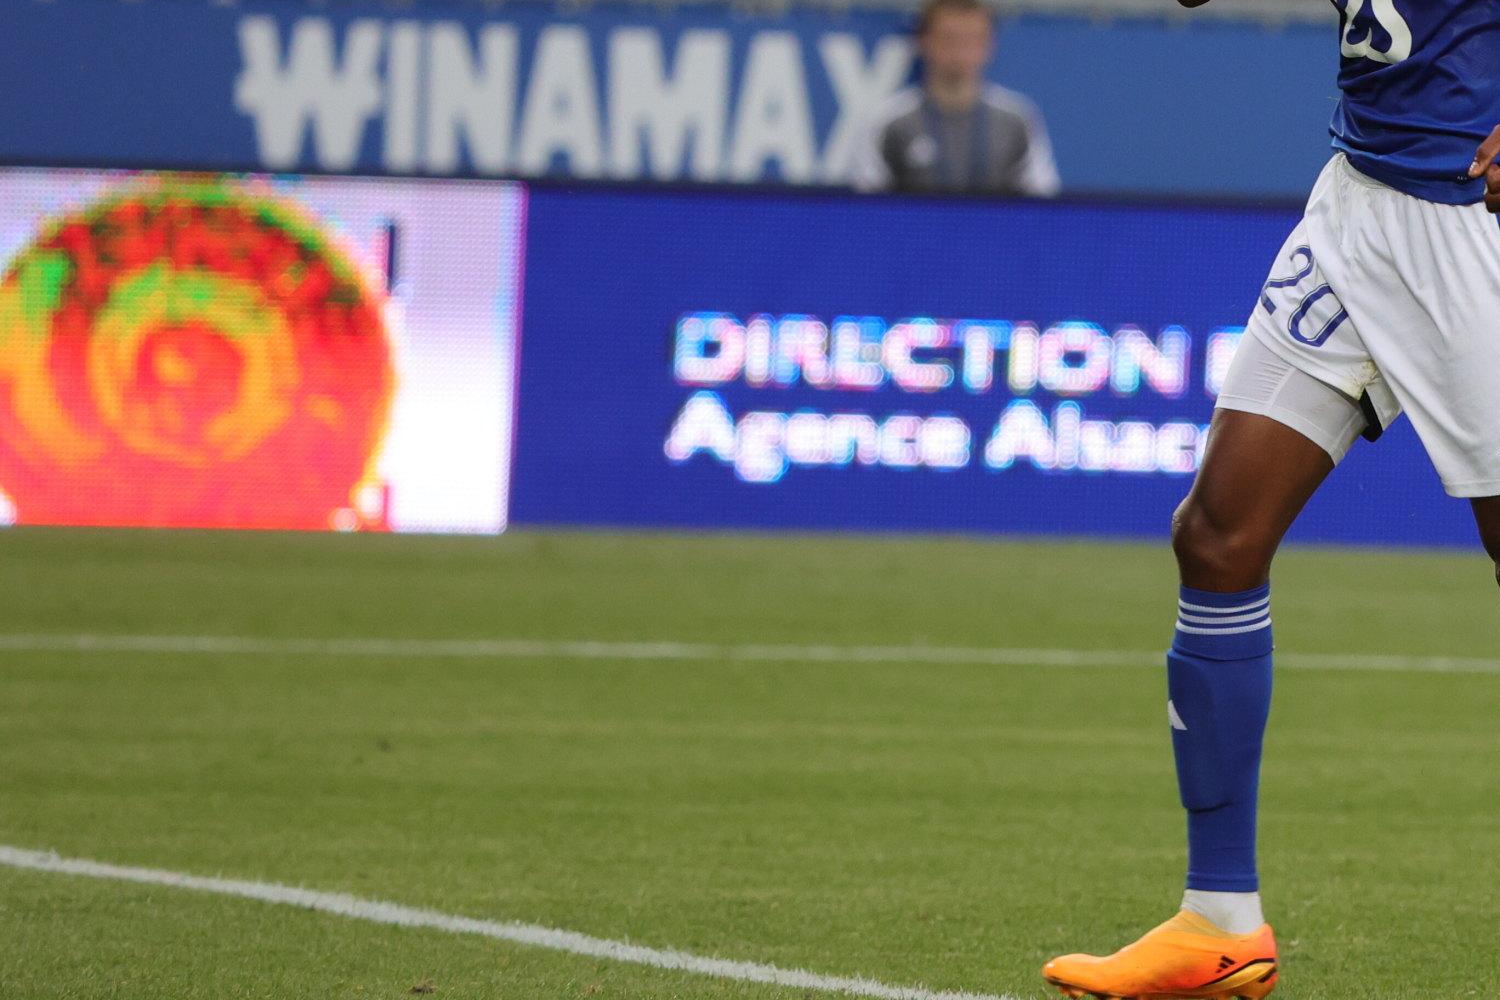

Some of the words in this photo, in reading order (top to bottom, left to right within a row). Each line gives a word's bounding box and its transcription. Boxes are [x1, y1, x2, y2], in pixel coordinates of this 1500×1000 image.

[234, 15, 916, 186] WINAMAX
[1260, 244, 1349, 347] 20
[674, 312, 1194, 397] DIRECTION
[665, 390, 971, 483] Agence
[985, 399, 1206, 474] Alsac
